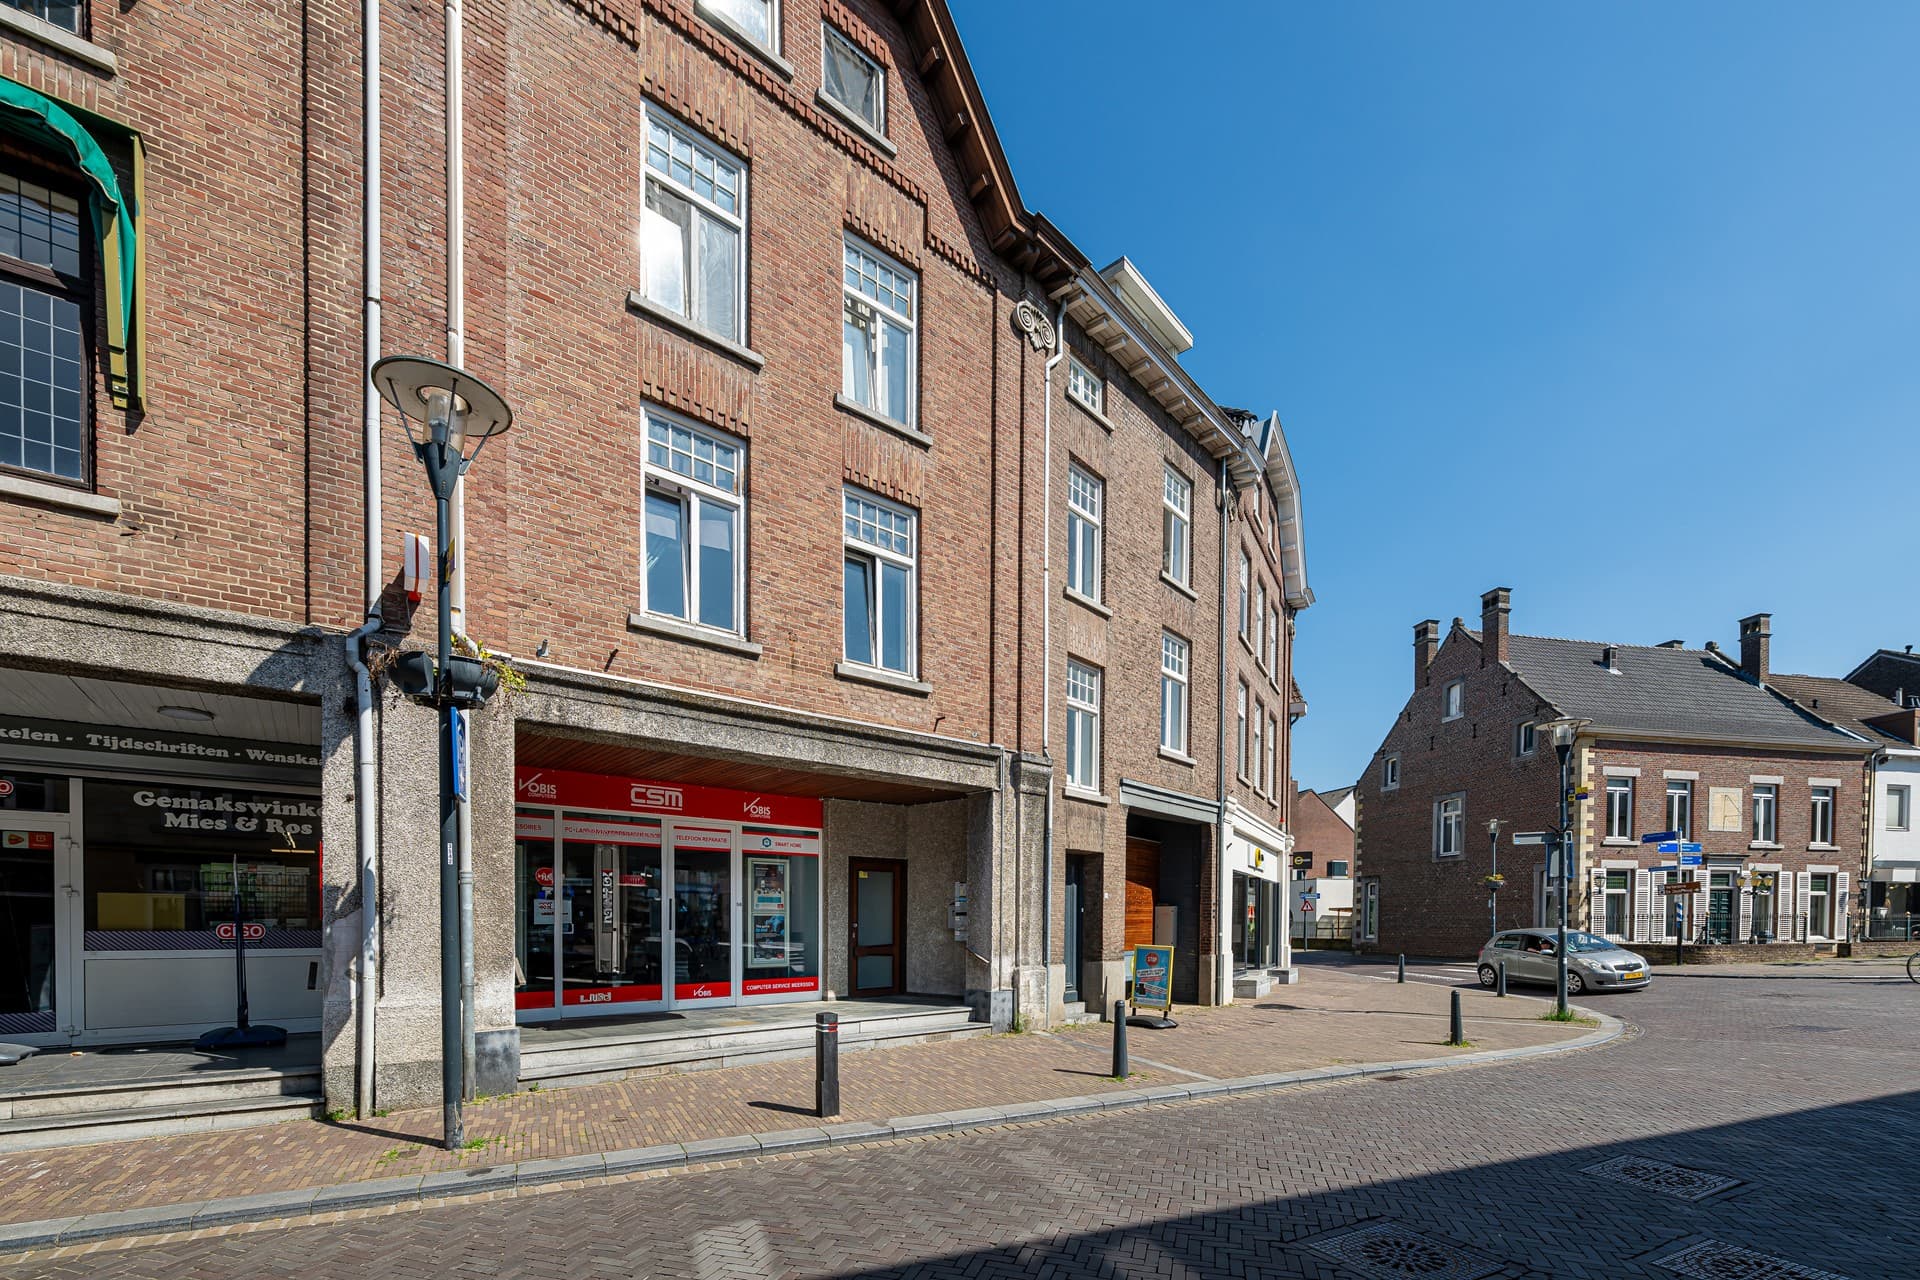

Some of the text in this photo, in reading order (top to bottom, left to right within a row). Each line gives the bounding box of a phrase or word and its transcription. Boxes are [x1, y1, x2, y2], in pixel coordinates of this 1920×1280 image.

[86, 733, 229, 758] Tijdschriften
[519, 773, 557, 795] VOBIS
[630, 787, 683, 807] CSM
[743, 797, 771, 815] VOBIS
[164, 812, 313, 835] Mies & Ros
